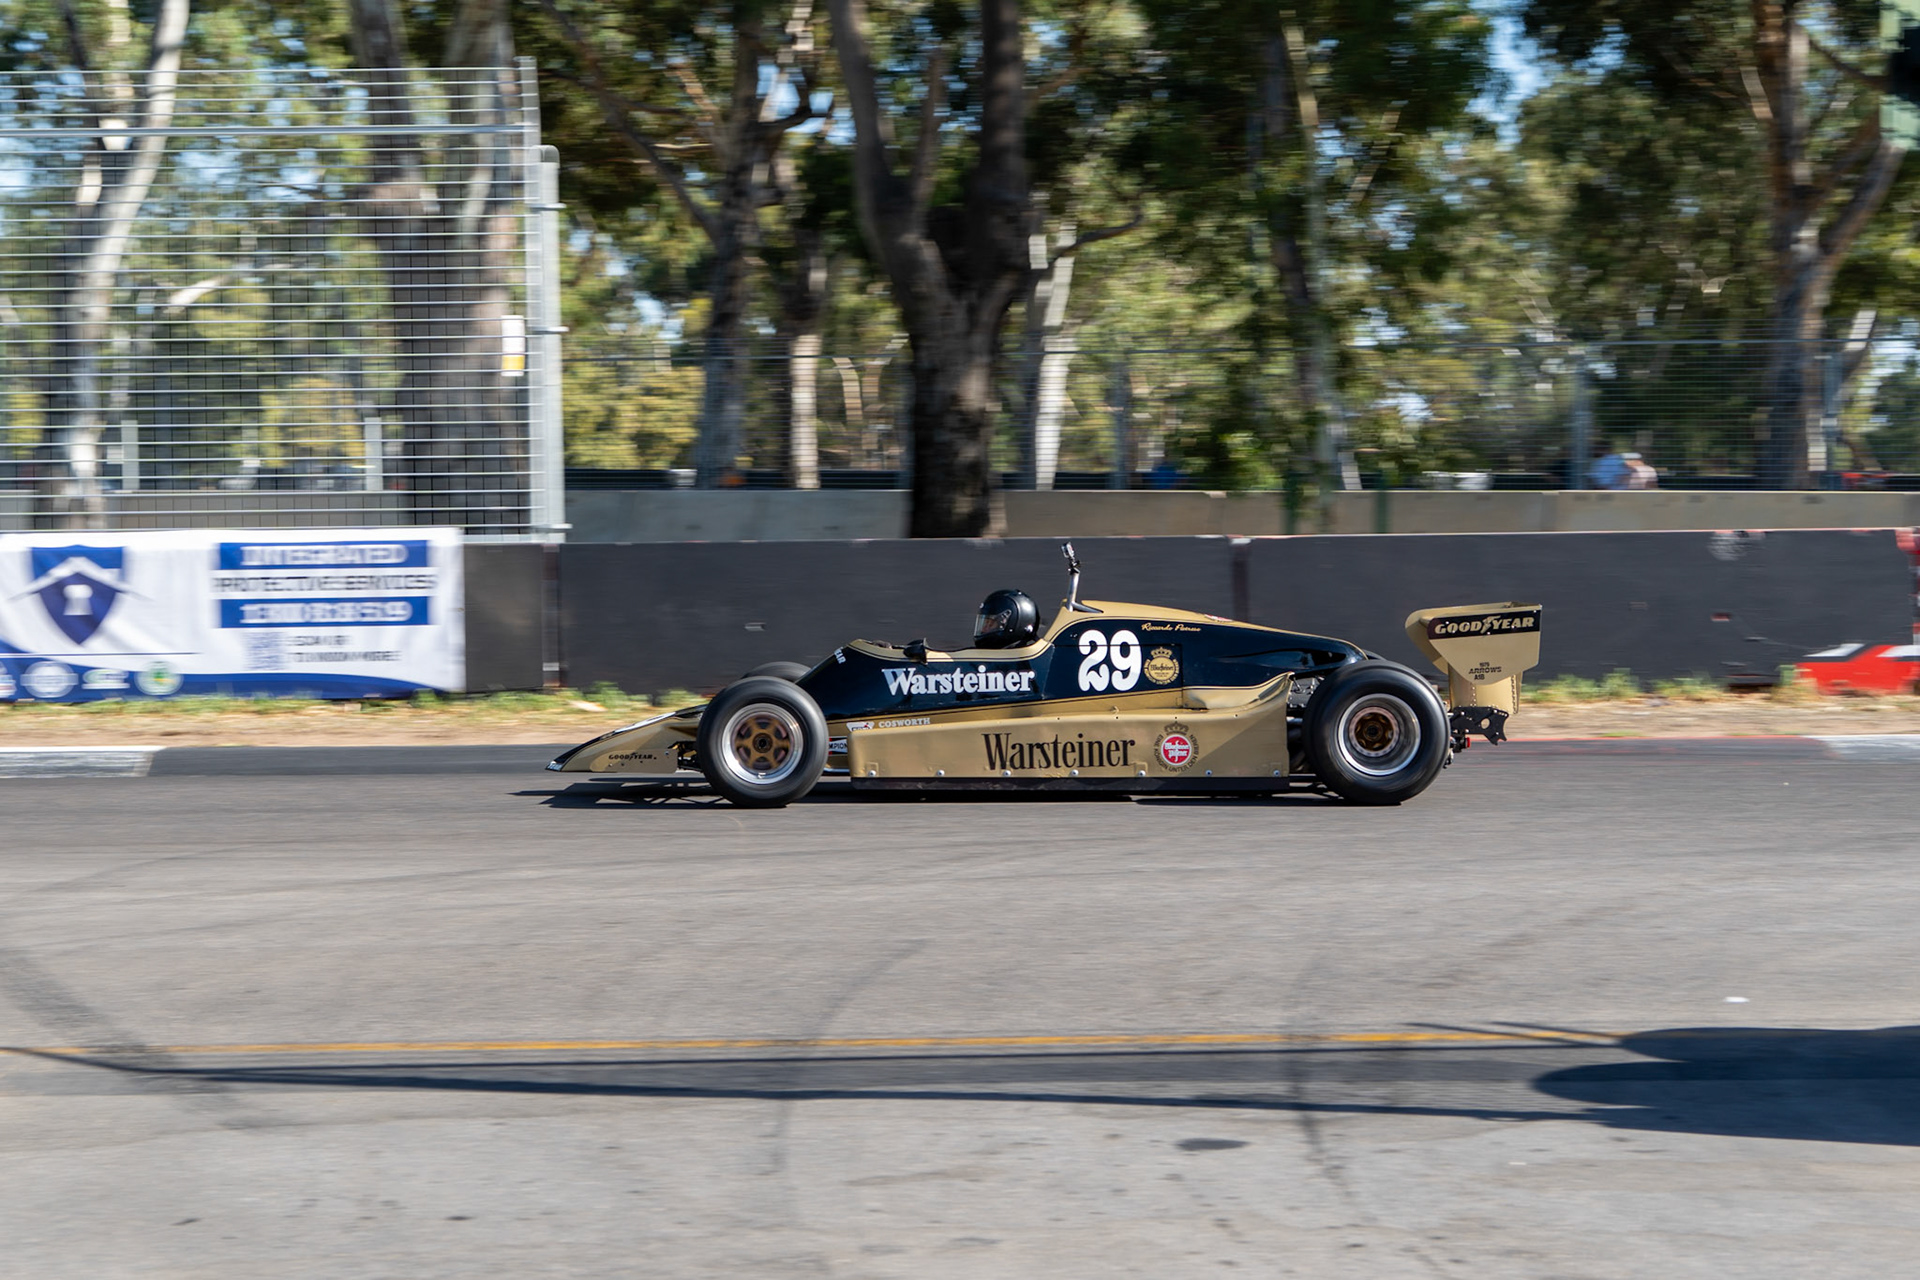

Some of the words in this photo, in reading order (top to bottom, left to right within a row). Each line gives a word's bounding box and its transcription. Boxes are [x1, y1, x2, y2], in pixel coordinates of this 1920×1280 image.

[1434, 616, 1535, 635] GOODYEAR
[1078, 629, 1142, 692] 29
[1468, 666, 1502, 674] ARROWS
[881, 665, 1035, 696] Warsteiner
[878, 717, 931, 729] COSWORTH
[608, 752, 653, 761] GOODYEAR
[981, 732, 1136, 771] Warsteiner
